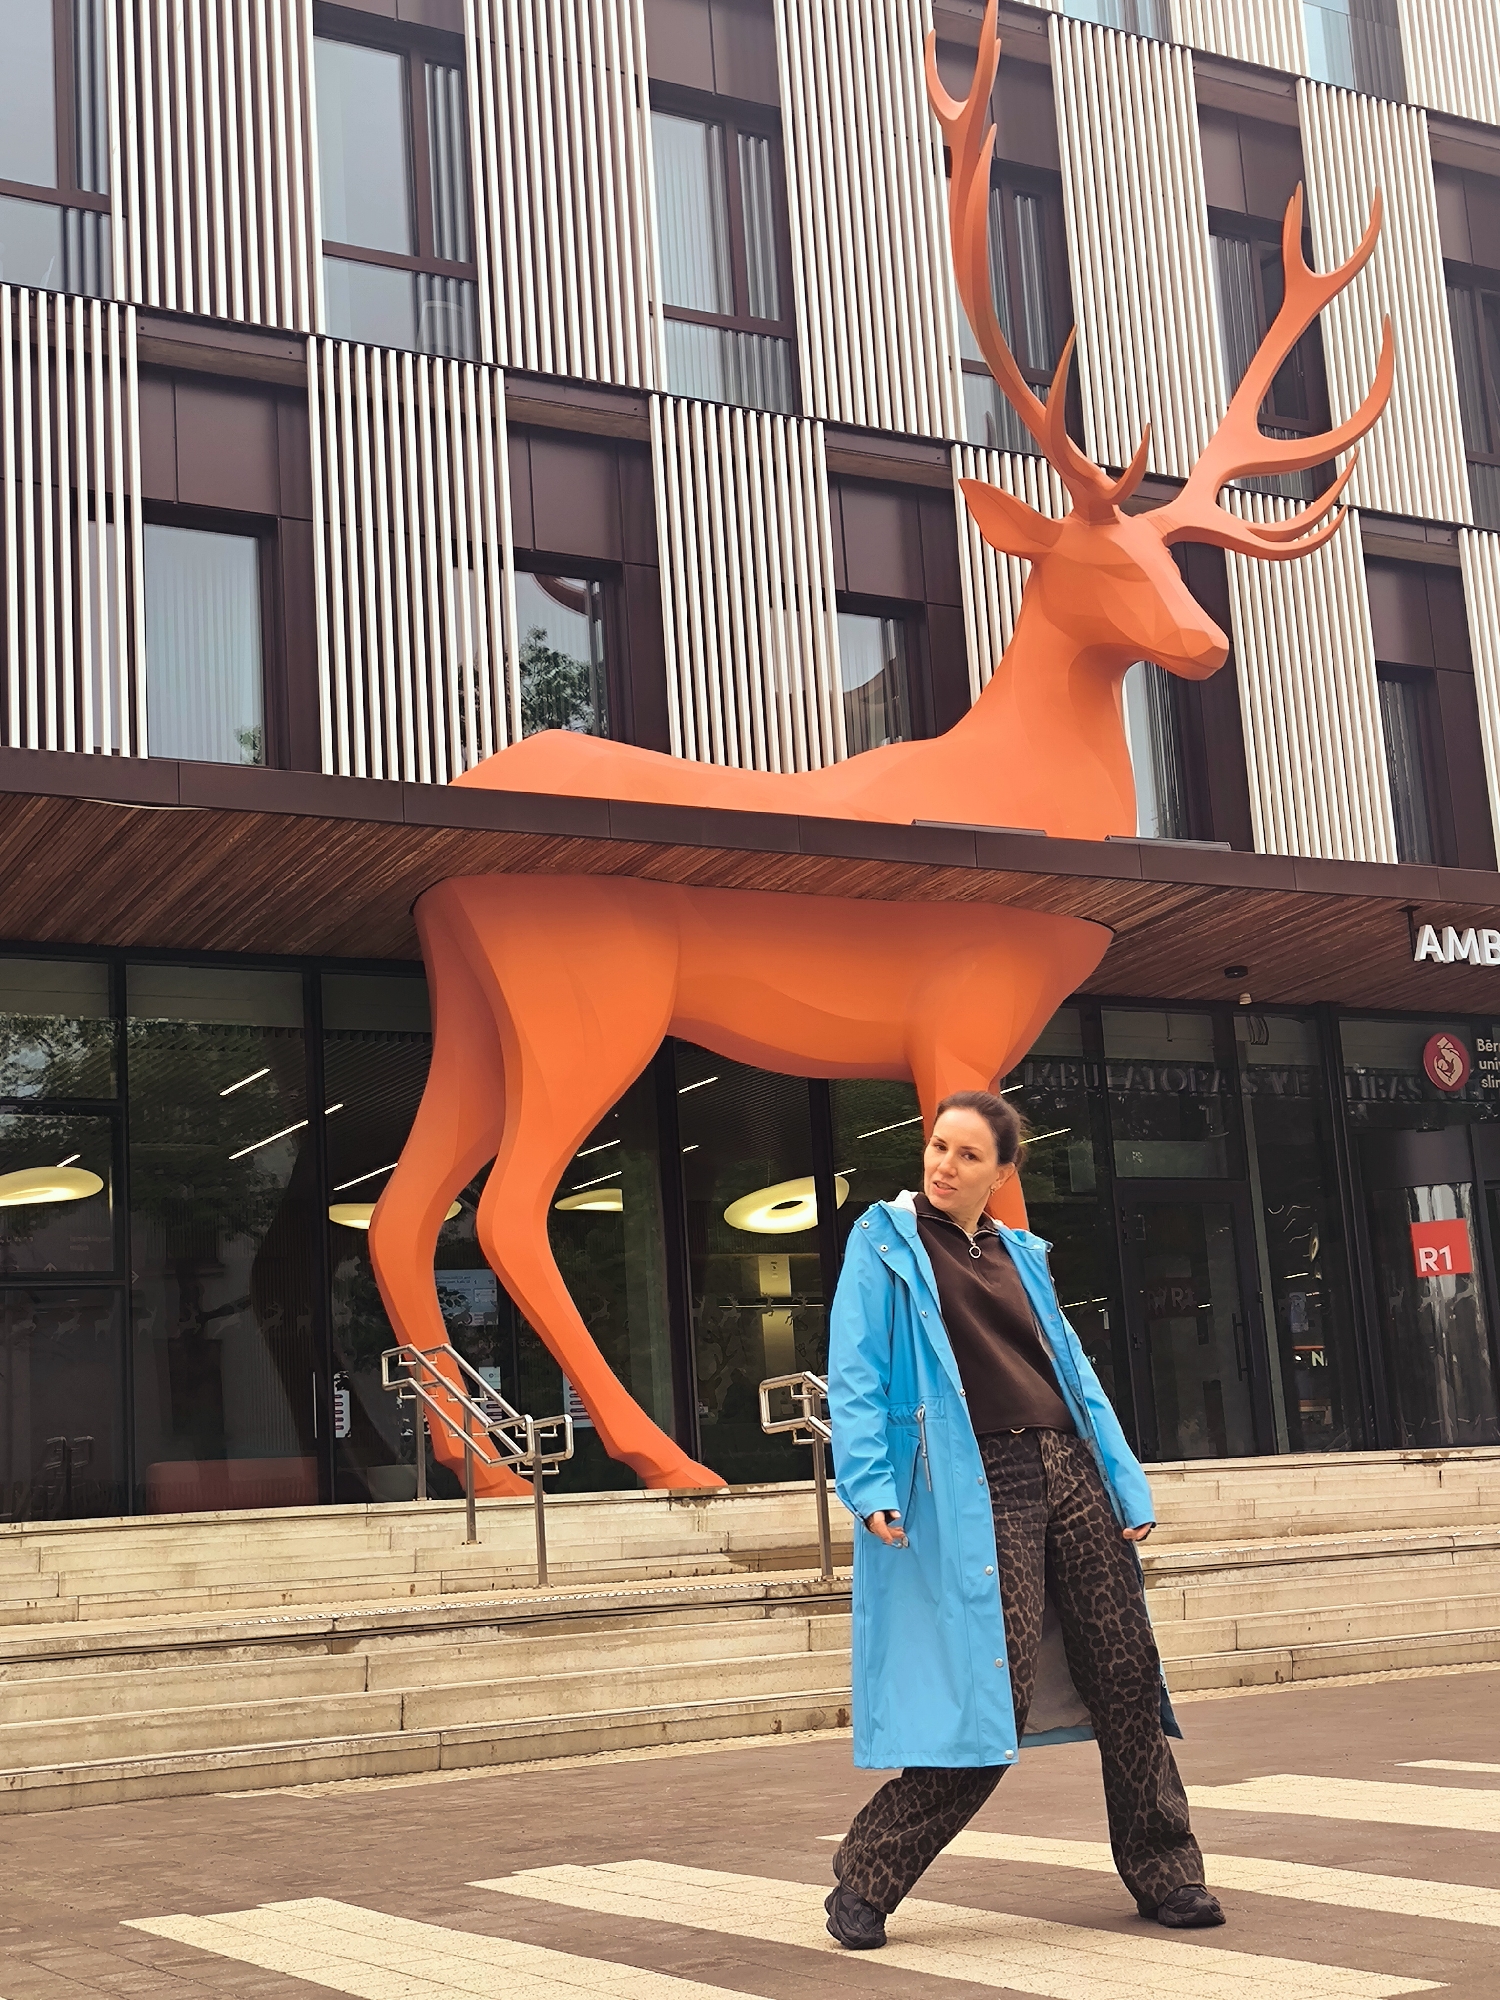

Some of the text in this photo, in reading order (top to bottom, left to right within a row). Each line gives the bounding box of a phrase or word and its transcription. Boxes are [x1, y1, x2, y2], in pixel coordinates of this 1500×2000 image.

[1414, 924, 1500, 966] AMB
[1477, 1038, 1500, 1052] Bēr
[1418, 1245, 1453, 1273] R1
